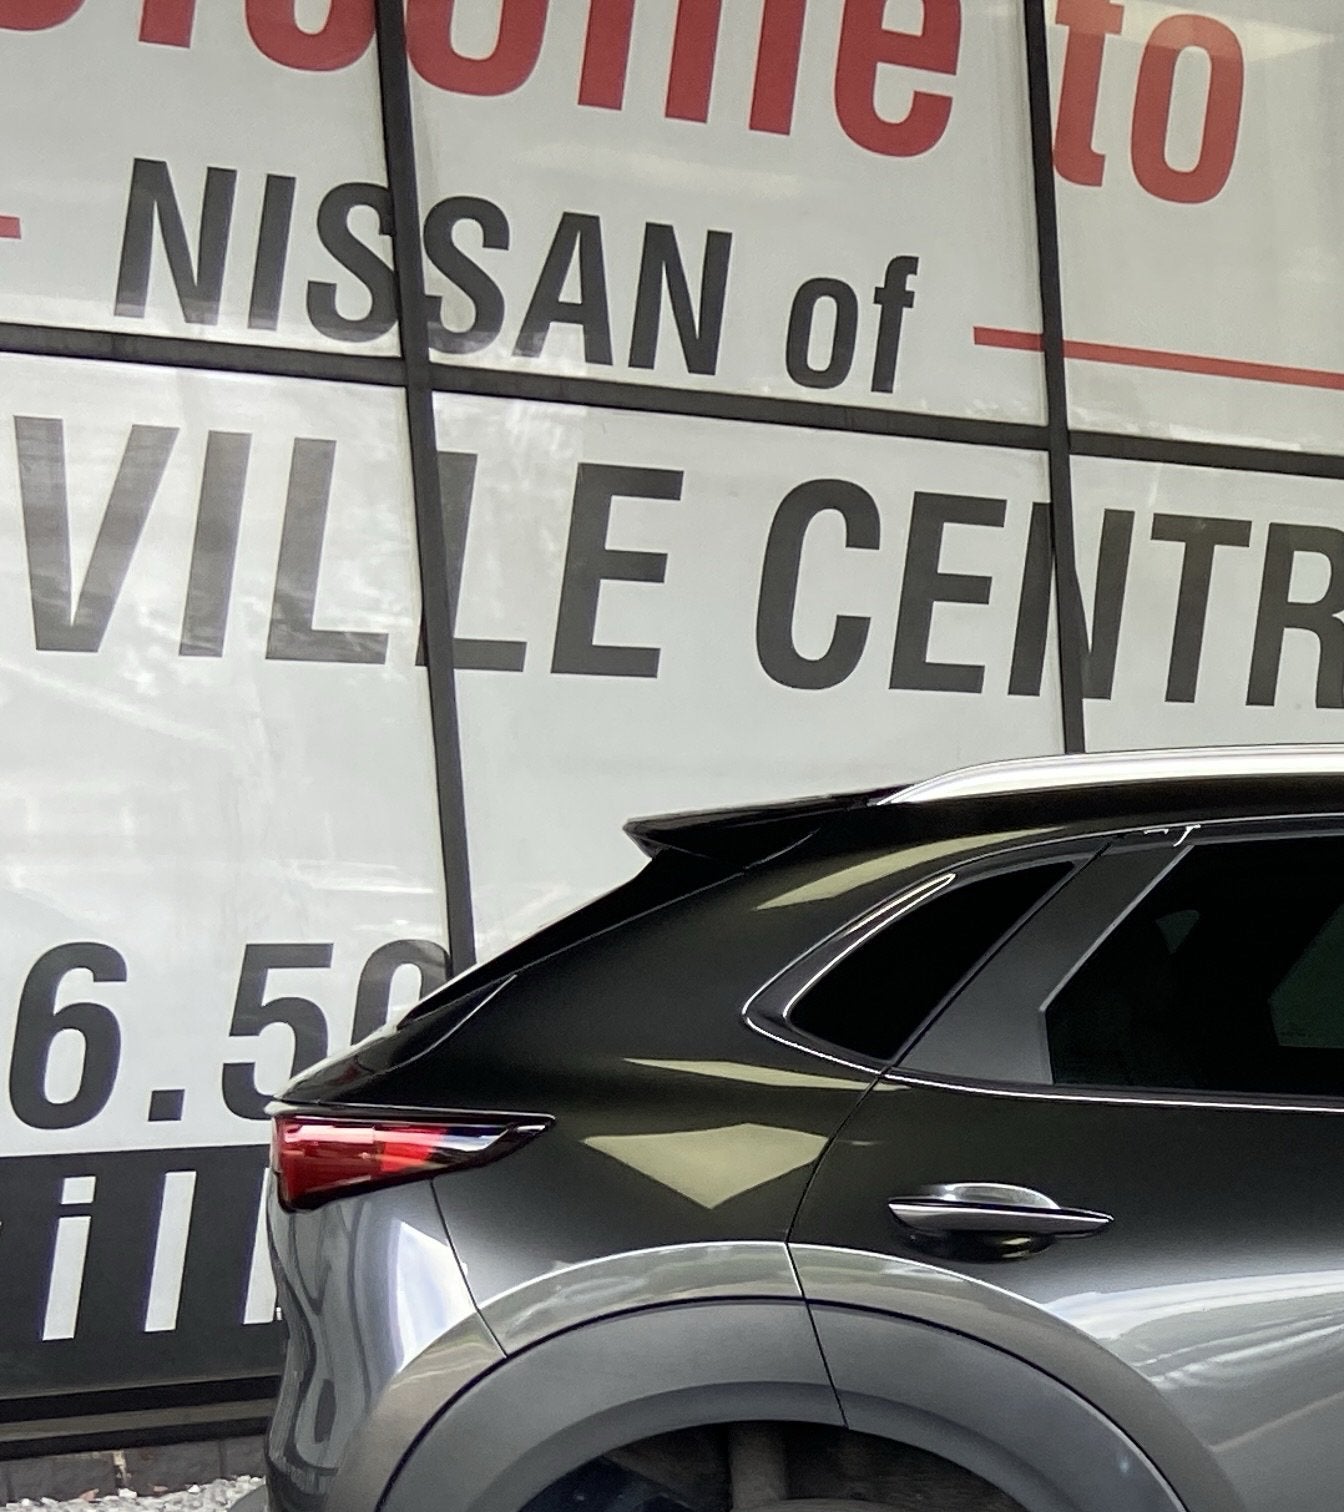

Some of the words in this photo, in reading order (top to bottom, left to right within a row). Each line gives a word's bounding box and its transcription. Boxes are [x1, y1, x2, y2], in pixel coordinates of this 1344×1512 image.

[1053, 0, 1245, 205] to
[114, 158, 733, 376] NISSAN
[785, 256, 920, 393] of
[14, 415, 685, 679] VILLE
